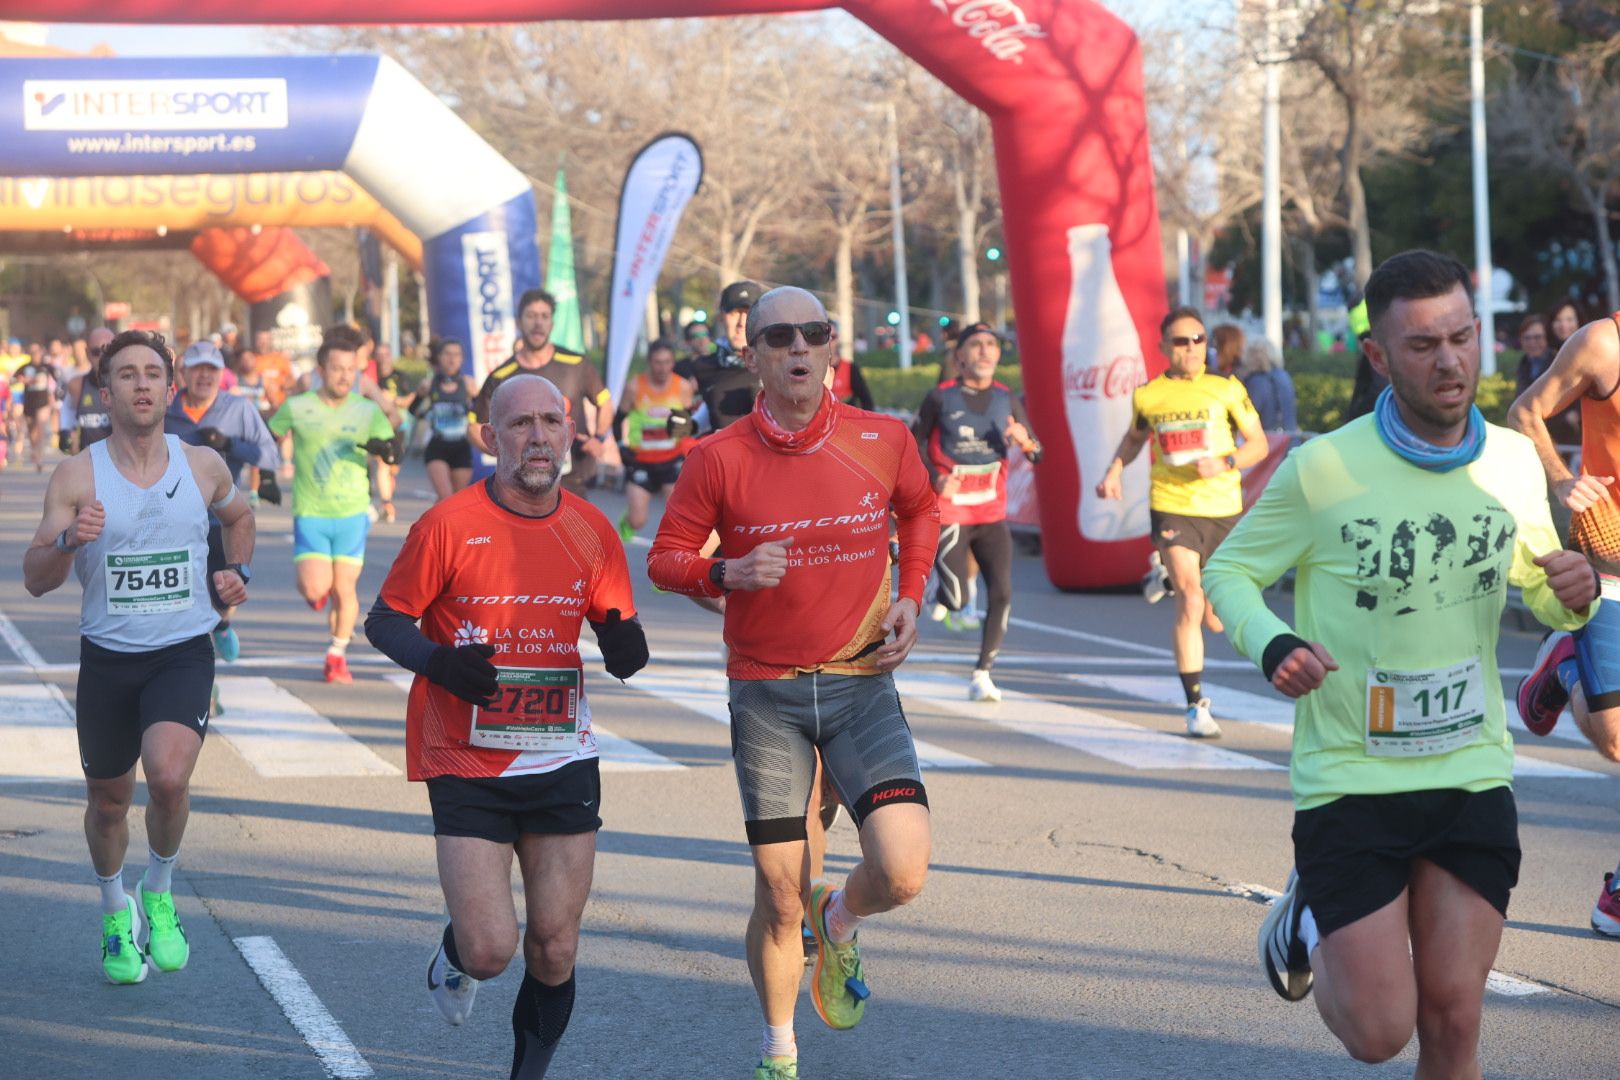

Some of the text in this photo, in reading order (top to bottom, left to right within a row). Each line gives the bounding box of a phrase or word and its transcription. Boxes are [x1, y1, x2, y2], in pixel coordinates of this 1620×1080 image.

[73, 91, 271, 115] INTERSPORT
[67, 133, 257, 155] www.intersport.es
[466, 535, 492, 545] 42K
[789, 543, 841, 556] LA CASA
[789, 547, 877, 568] DE LOS AROMAS
[111, 567, 180, 591] 7548
[495, 627, 555, 639] LA CASA
[494, 643, 579, 655] DE LOS AROM
[483, 688, 564, 715] 2720
[1412, 680, 1468, 718] 117
[871, 787, 916, 804] HOKO
